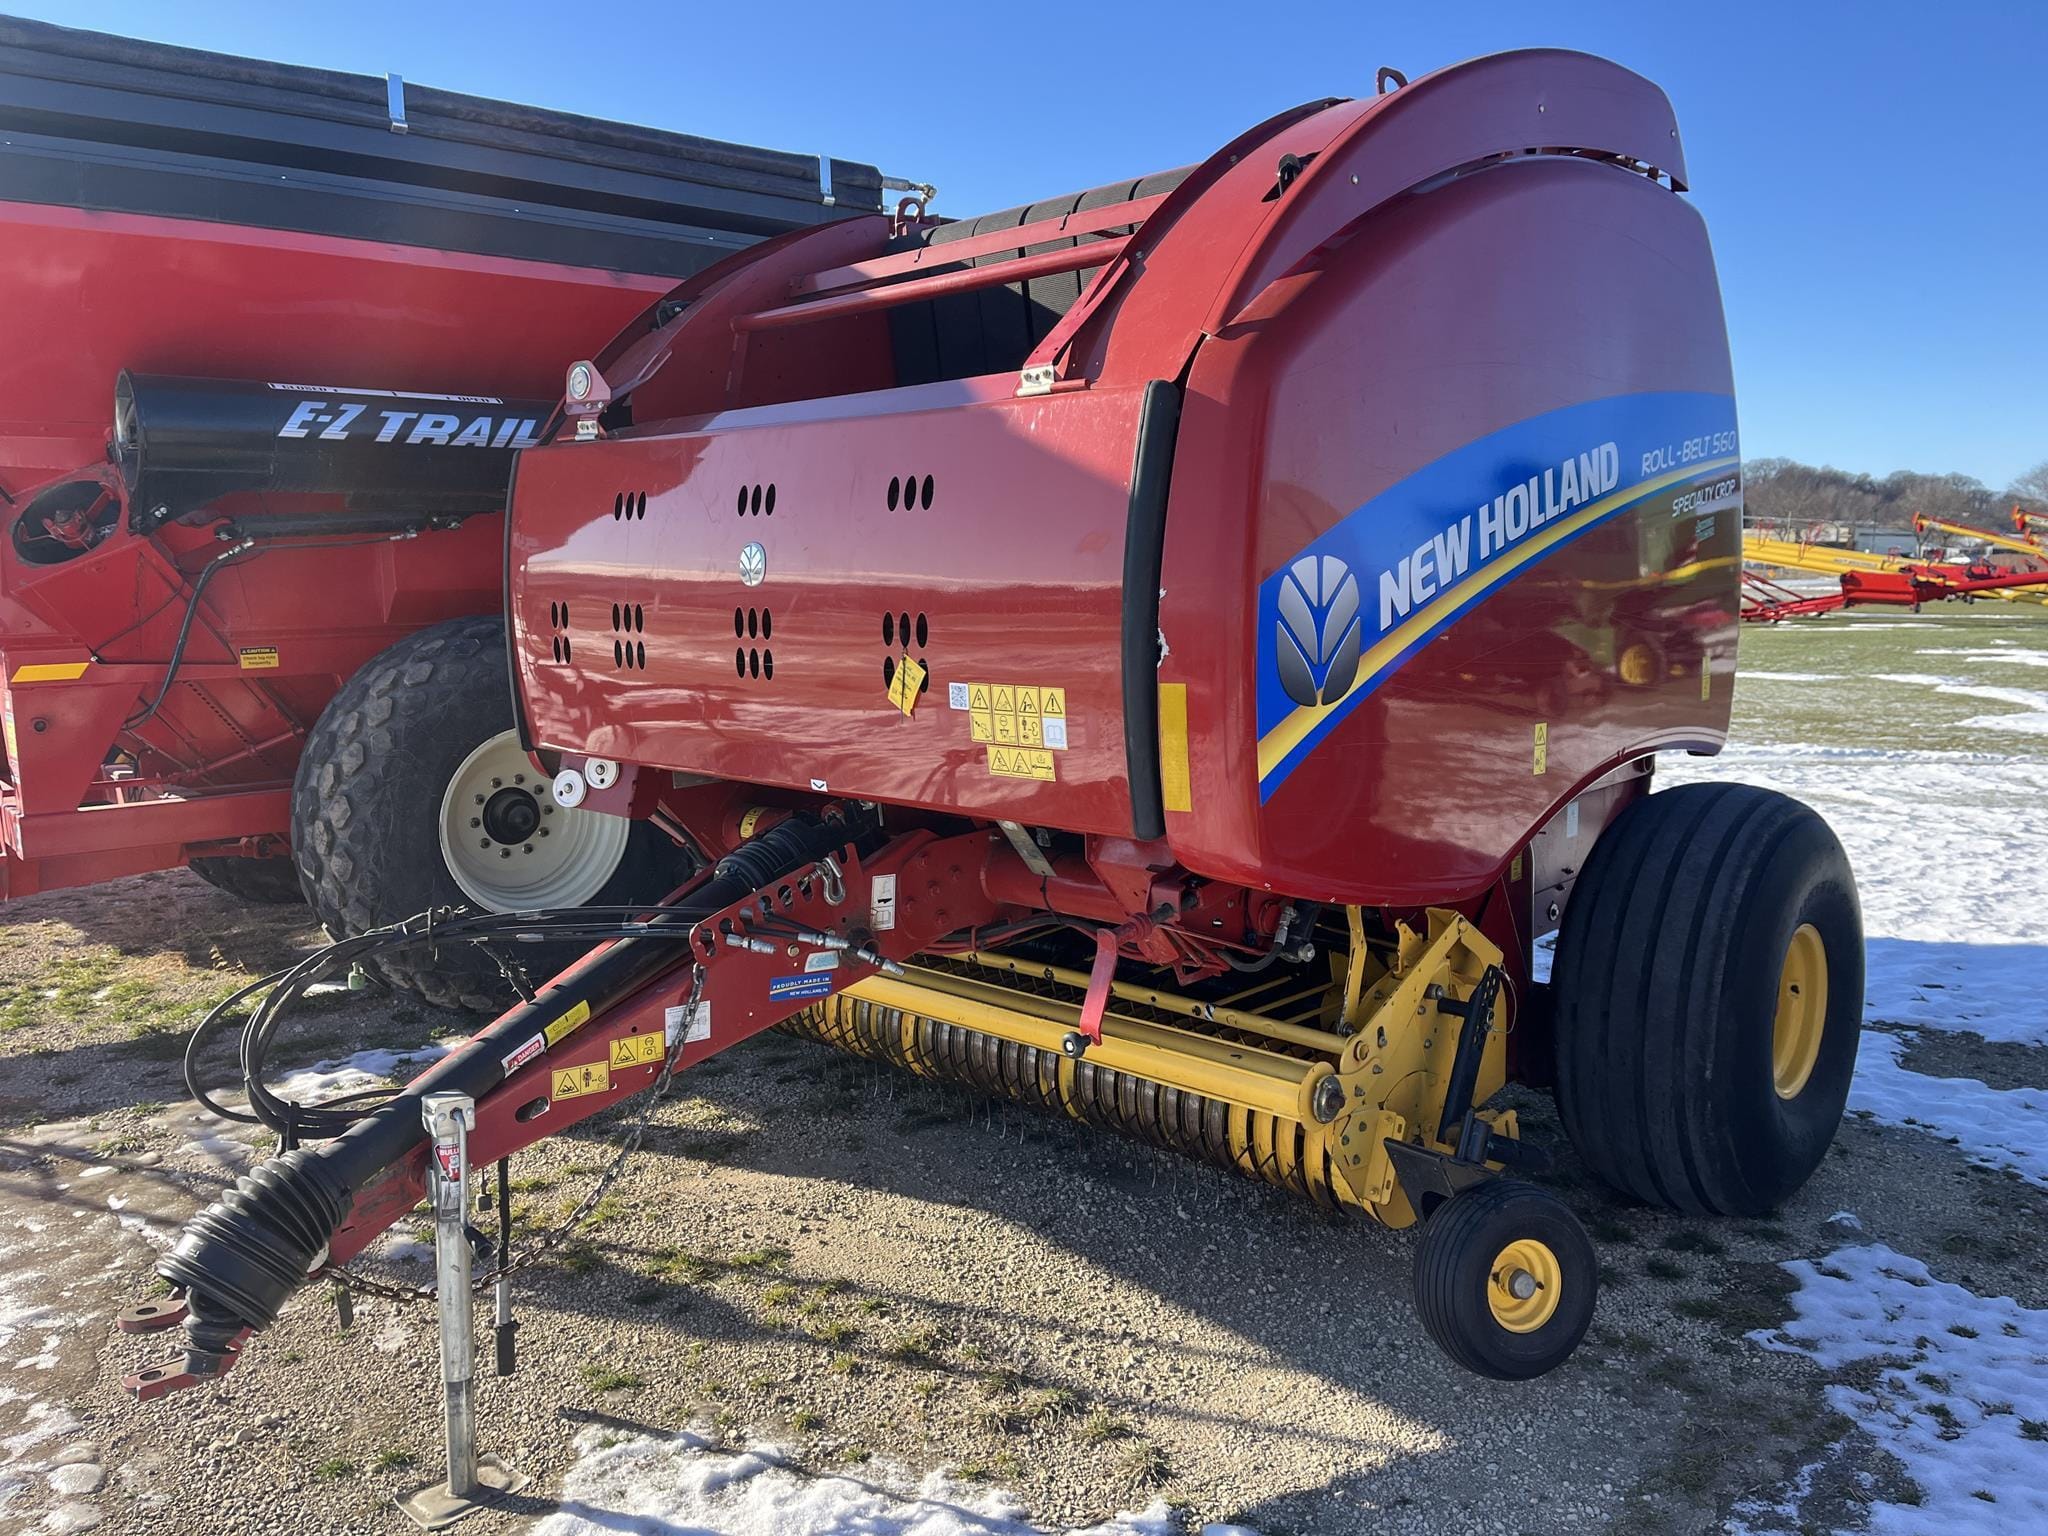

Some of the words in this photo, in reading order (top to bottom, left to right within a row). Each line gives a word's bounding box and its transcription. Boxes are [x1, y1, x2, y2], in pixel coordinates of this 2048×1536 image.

[278, 401, 368, 440] E-Z
[375, 411, 541, 449] TRAIL
[1711, 430, 1736, 455] 560
[1671, 485, 1715, 518] SPECIALTY
[1715, 479, 1736, 500] CROP
[1379, 514, 1471, 632] NEW
[1478, 441, 1619, 561] HOLLAND
[772, 980, 802, 990] PROUDLY
[517, 1041, 540, 1062] DANGER
[439, 1147, 460, 1156] BULL
